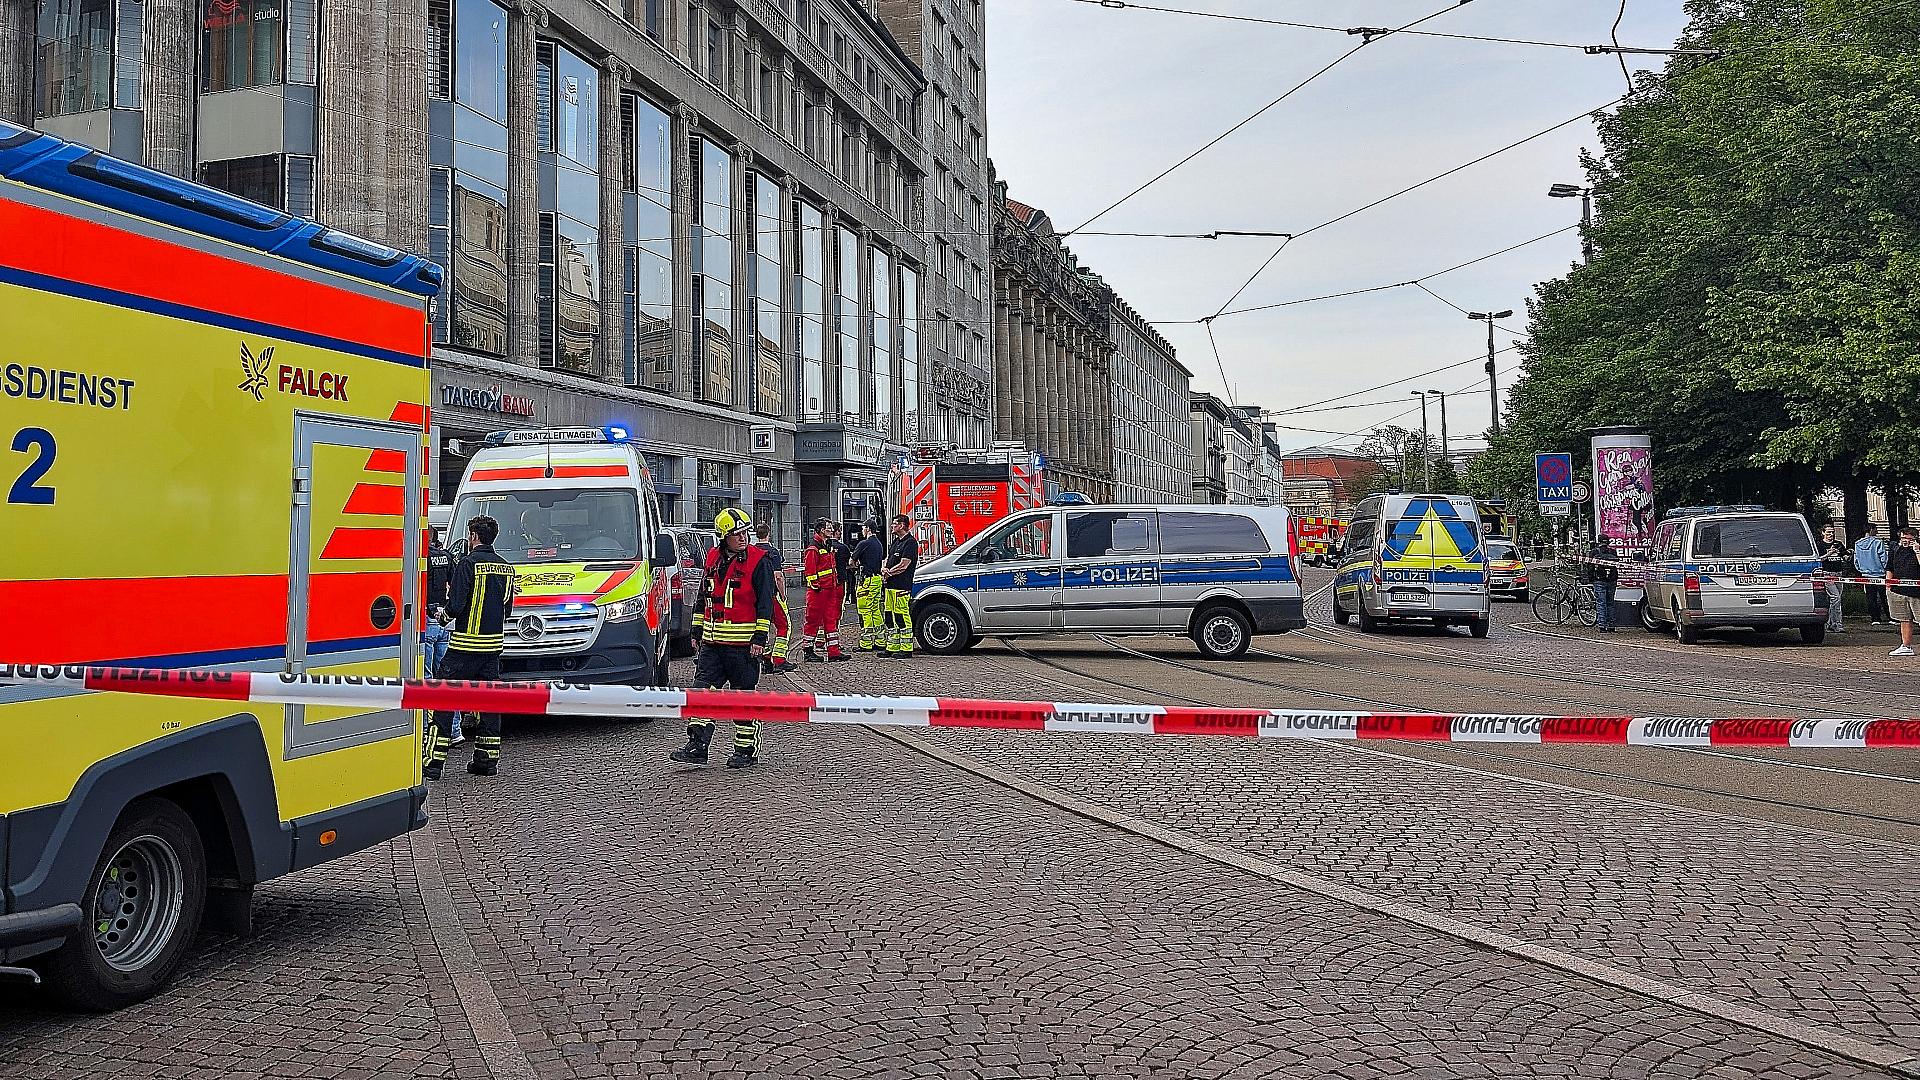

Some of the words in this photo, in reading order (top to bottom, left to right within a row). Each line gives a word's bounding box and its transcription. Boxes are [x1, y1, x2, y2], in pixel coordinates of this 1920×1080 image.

[254, 7, 279, 21] studio
[0, 363, 135, 410] SDIENST
[278, 364, 349, 402] FALCK
[513, 430, 597, 441] EINSATZLEITWAGEN
[802, 439, 842, 449] Königsbau
[7, 426, 57, 505] 2
[1603, 450, 1633, 473] Rea
[1540, 486, 1569, 498] TAXI
[1573, 488, 1585, 498] 50
[970, 499, 993, 515] 112
[1090, 566, 1158, 583] POLIZEI
[1386, 571, 1429, 581] POLIZEI
[1698, 564, 1748, 574] POLIZEI
